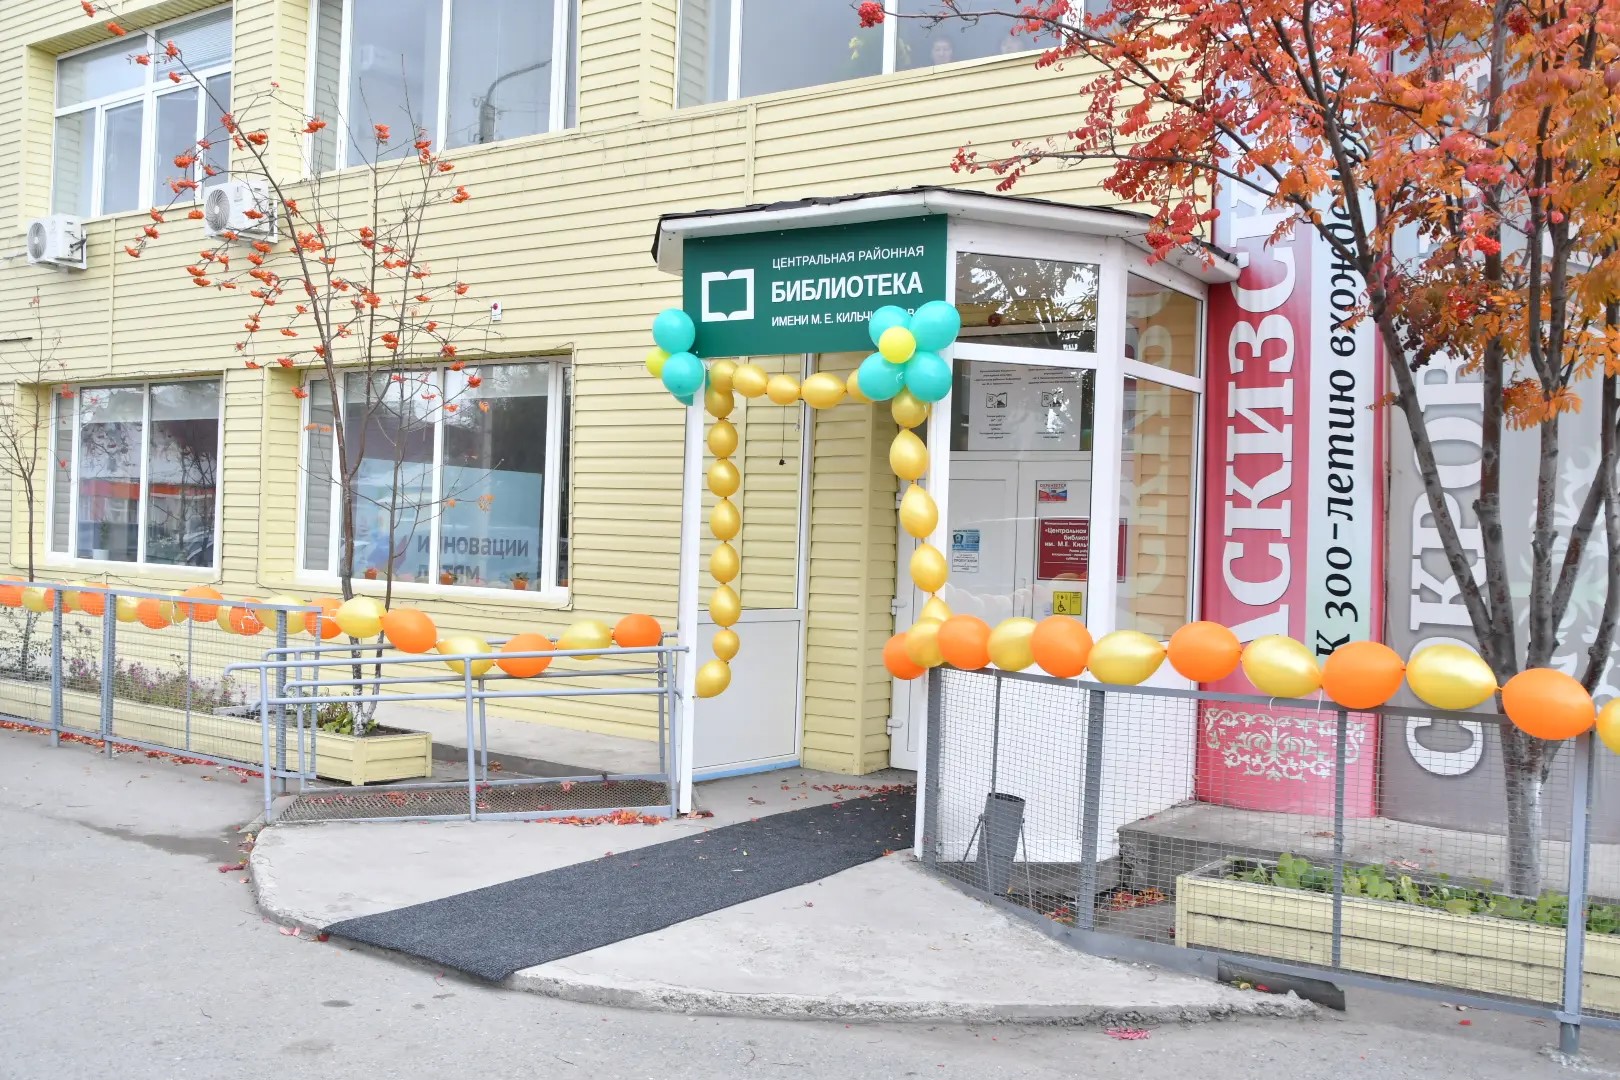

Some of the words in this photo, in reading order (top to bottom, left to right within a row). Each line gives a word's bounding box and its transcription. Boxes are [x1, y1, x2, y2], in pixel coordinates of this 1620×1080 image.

[772, 251, 855, 270] ЦЕНТРАЛЬНАЯ
[858, 245, 925, 262] РАЙОННАЯ
[771, 271, 923, 303] БИБЛИОТЕКА
[772, 314, 809, 327] ИМЕНИ
[811, 313, 823, 326] М.
[824, 312, 834, 325] Е.
[1325, 368, 1358, 623] 300-летию
[417, 534, 529, 559] иновации
